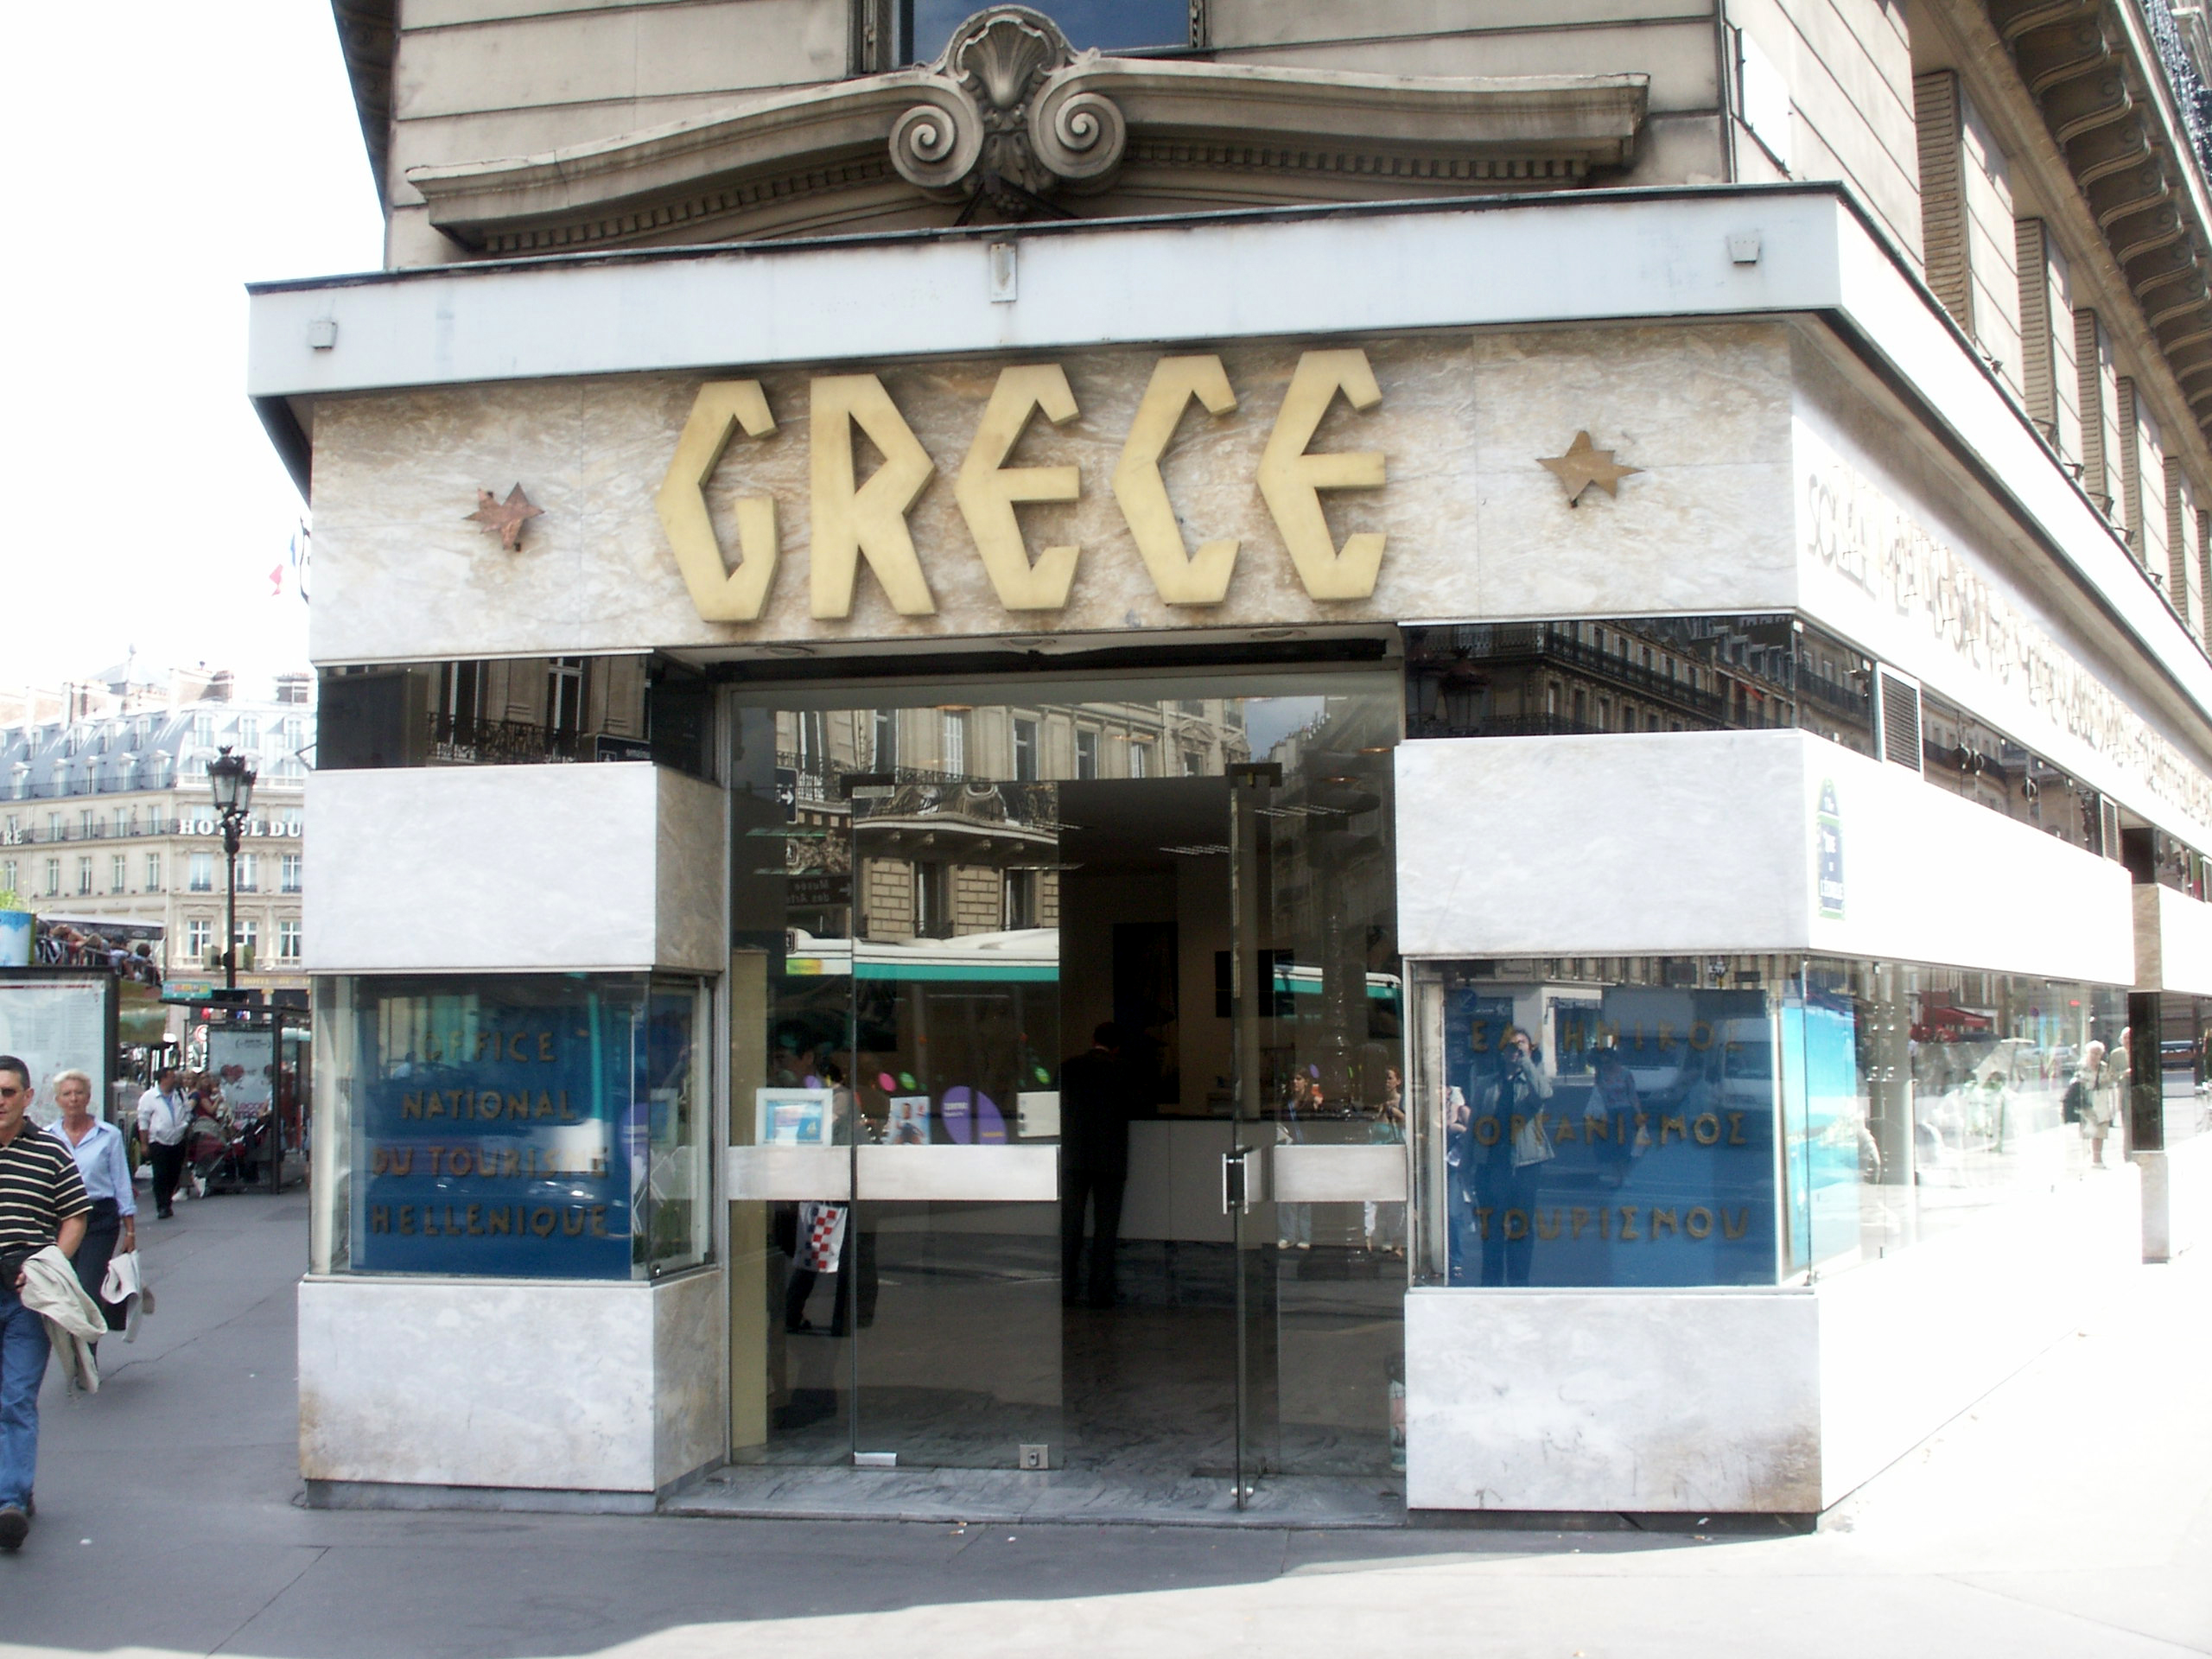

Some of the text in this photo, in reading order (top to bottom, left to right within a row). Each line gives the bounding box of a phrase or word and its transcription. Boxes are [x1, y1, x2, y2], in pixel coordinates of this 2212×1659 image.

[656, 349, 1387, 622] GRECE
[424, 1031, 556, 1063] OFFICE
[402, 1090, 576, 1120] NATIONAL
[372, 1146, 609, 1177] DU TOURISME
[372, 1205, 610, 1237] HELLENIQUE
